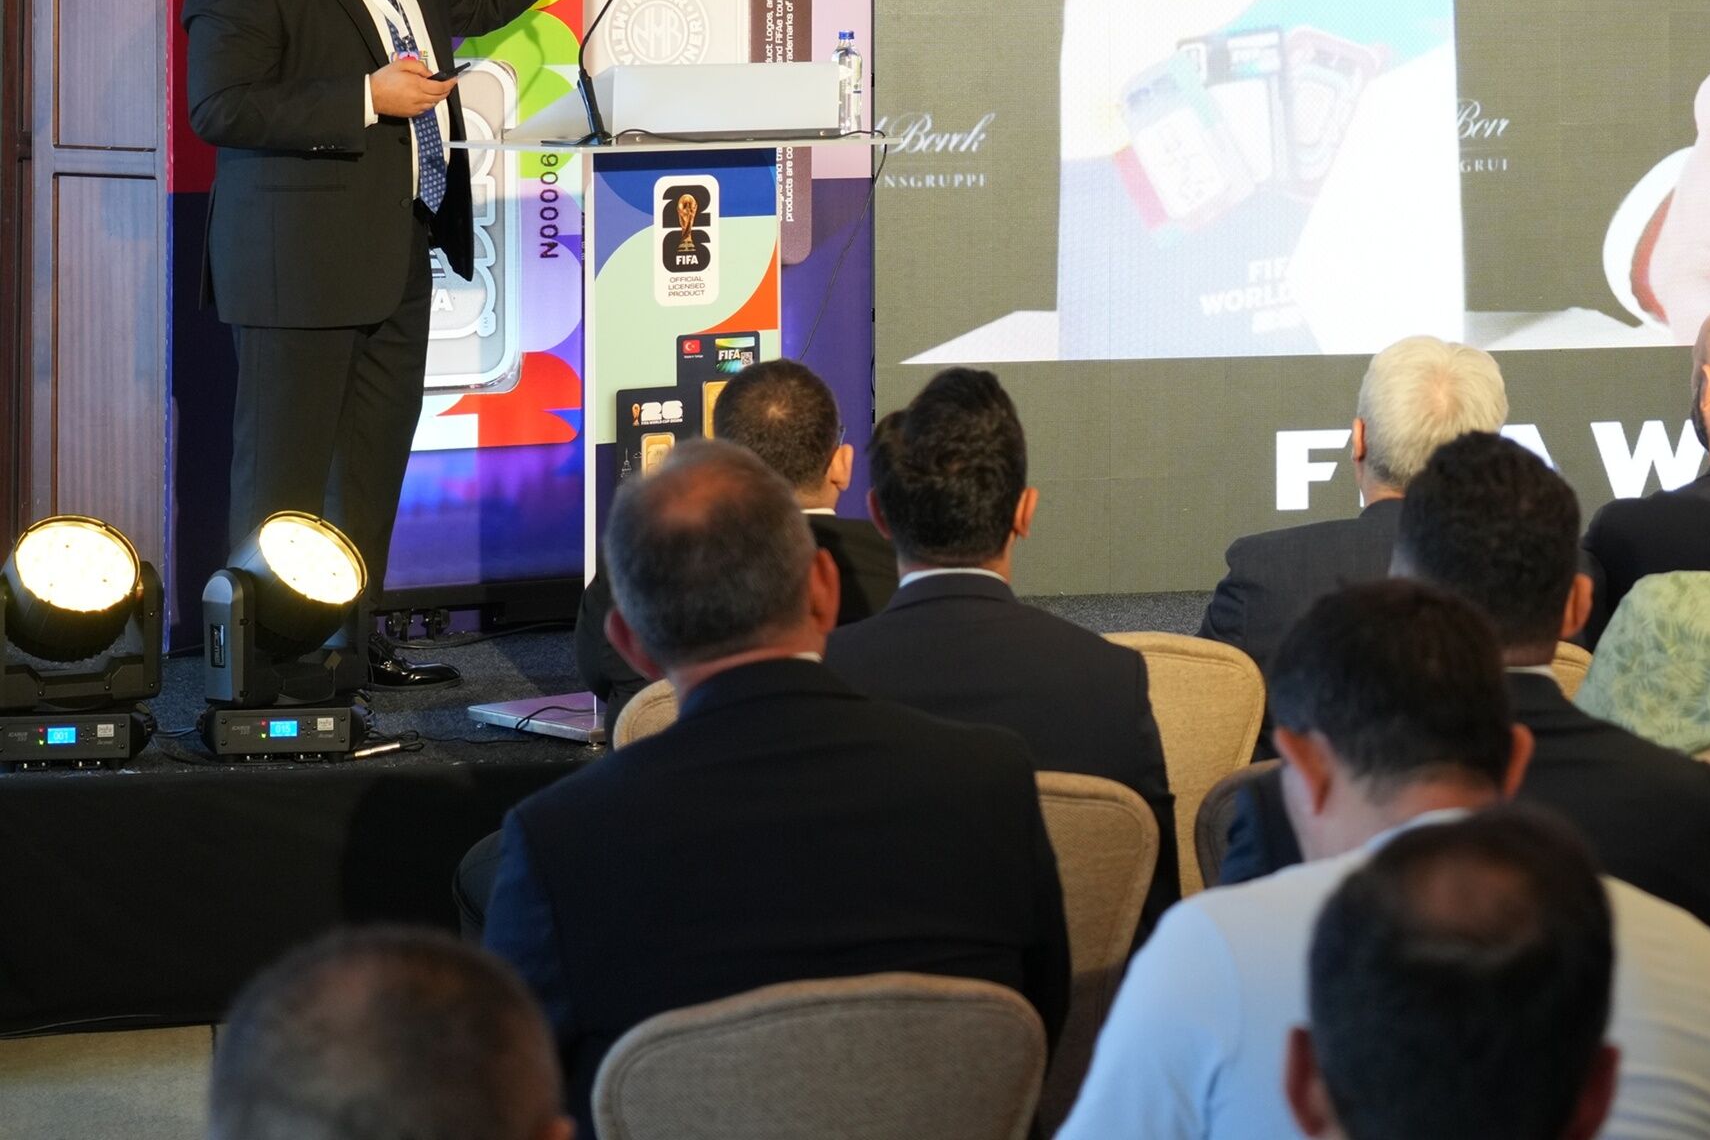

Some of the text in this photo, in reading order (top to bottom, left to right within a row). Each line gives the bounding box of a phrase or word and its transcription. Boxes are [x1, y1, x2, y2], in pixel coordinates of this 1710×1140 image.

[785, 1, 794, 12] of
[785, 14, 794, 64] rademarks
[785, 161, 793, 177] are
[540, 153, 559, 259] N00006
[785, 178, 794, 222] products
[676, 254, 699, 266] FIFA
[669, 276, 704, 284] OFFICIAL
[668, 282, 705, 291] LICENSED
[718, 349, 741, 361] FIFA
